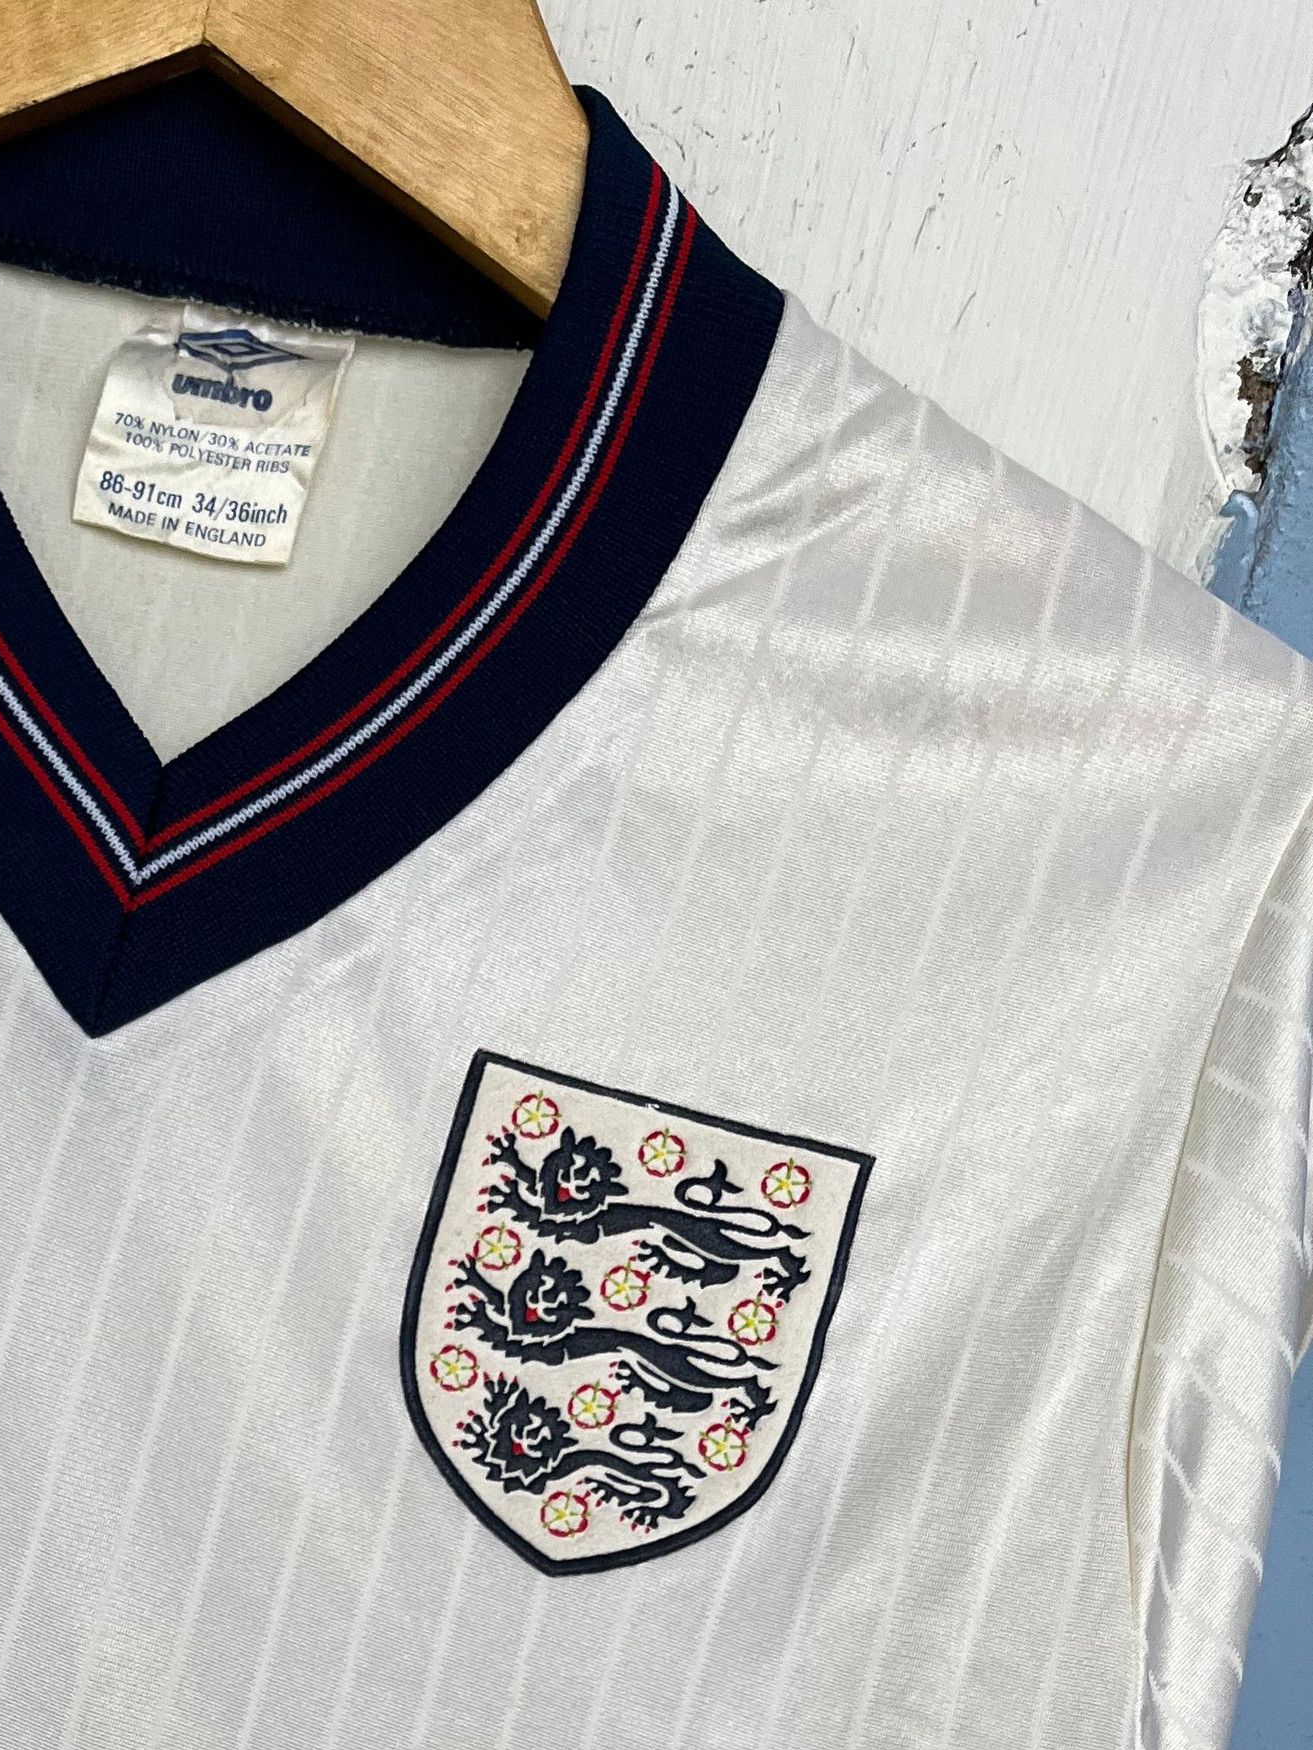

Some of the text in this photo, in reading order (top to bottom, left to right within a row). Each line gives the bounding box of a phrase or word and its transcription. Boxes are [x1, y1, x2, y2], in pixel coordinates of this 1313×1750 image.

[171, 372, 273, 412] umbro
[115, 412, 144, 430] 70%
[245, 441, 311, 457] ACETATE
[125, 431, 289, 474] 100% POLYESTER RIBS
[108, 502, 267, 547] MADE IN ENGLAND
